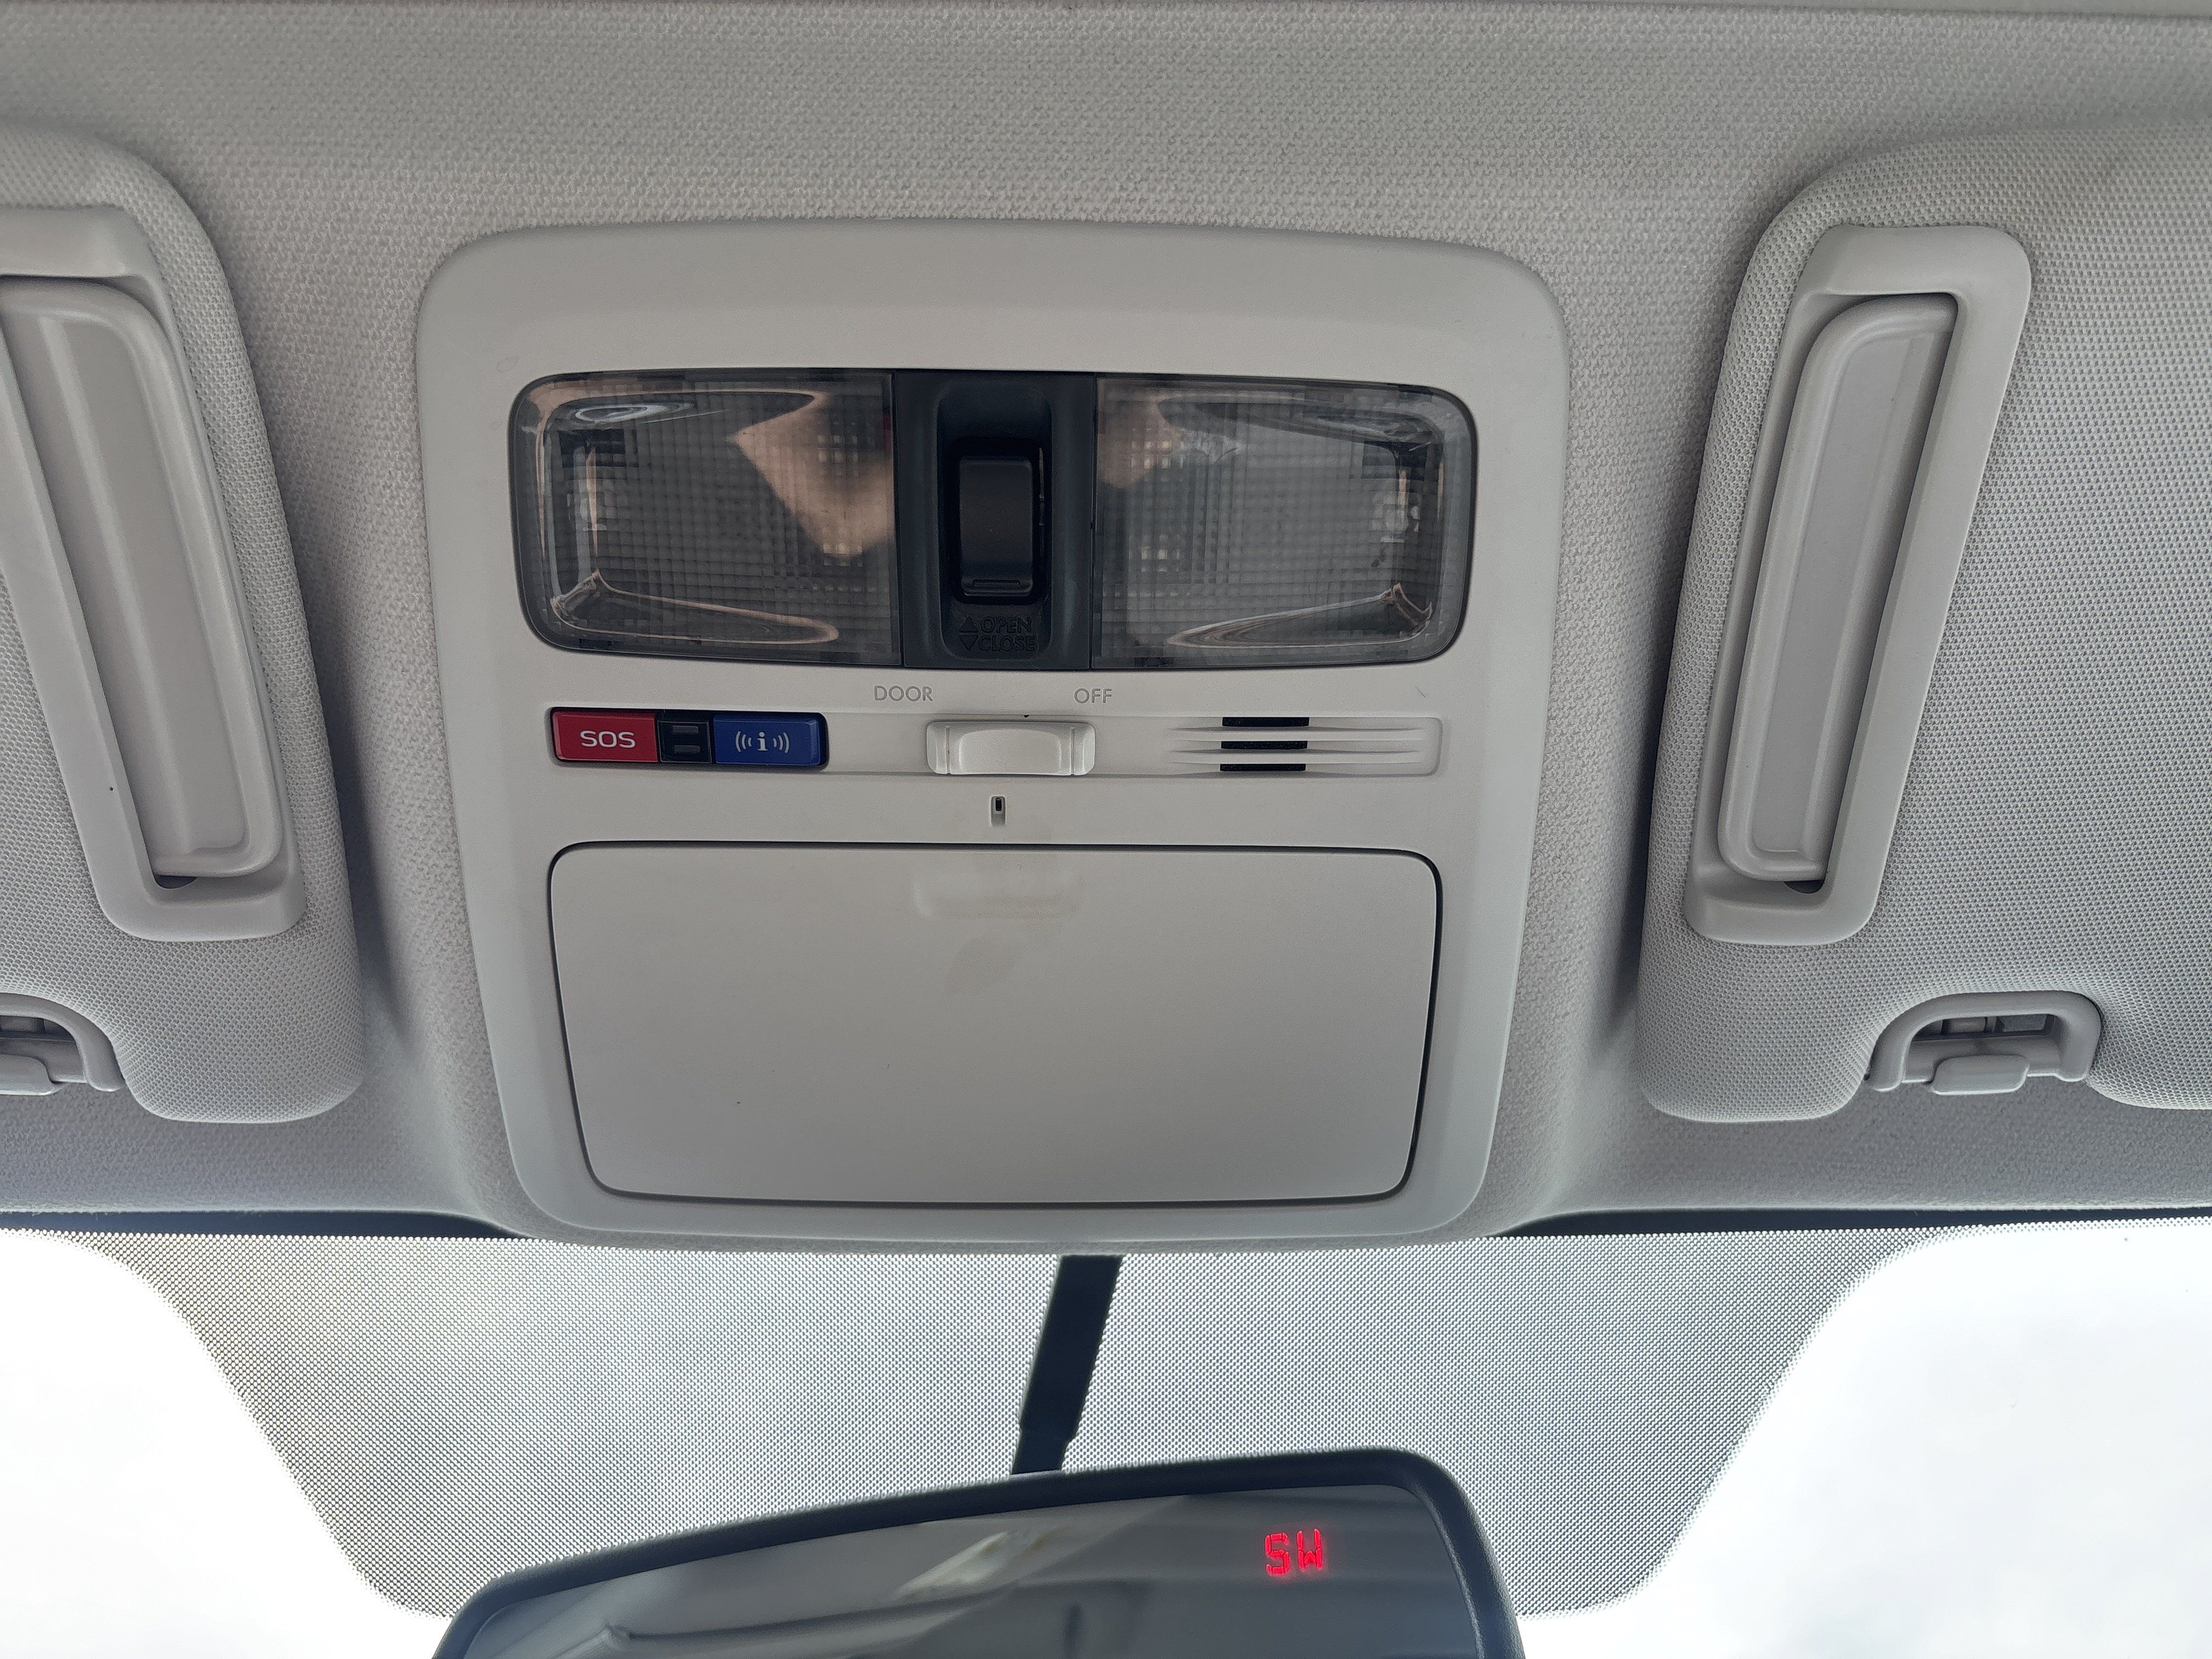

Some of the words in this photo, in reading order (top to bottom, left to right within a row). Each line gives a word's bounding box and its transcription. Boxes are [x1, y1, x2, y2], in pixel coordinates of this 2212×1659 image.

[980, 617, 1032, 633] OPEN
[978, 635, 1036, 652] CLOSE
[873, 685, 933, 702] DOOR
[1074, 688, 1112, 704] OFF
[580, 730, 636, 749] SOS
[1264, 1528, 1323, 1576] SW
